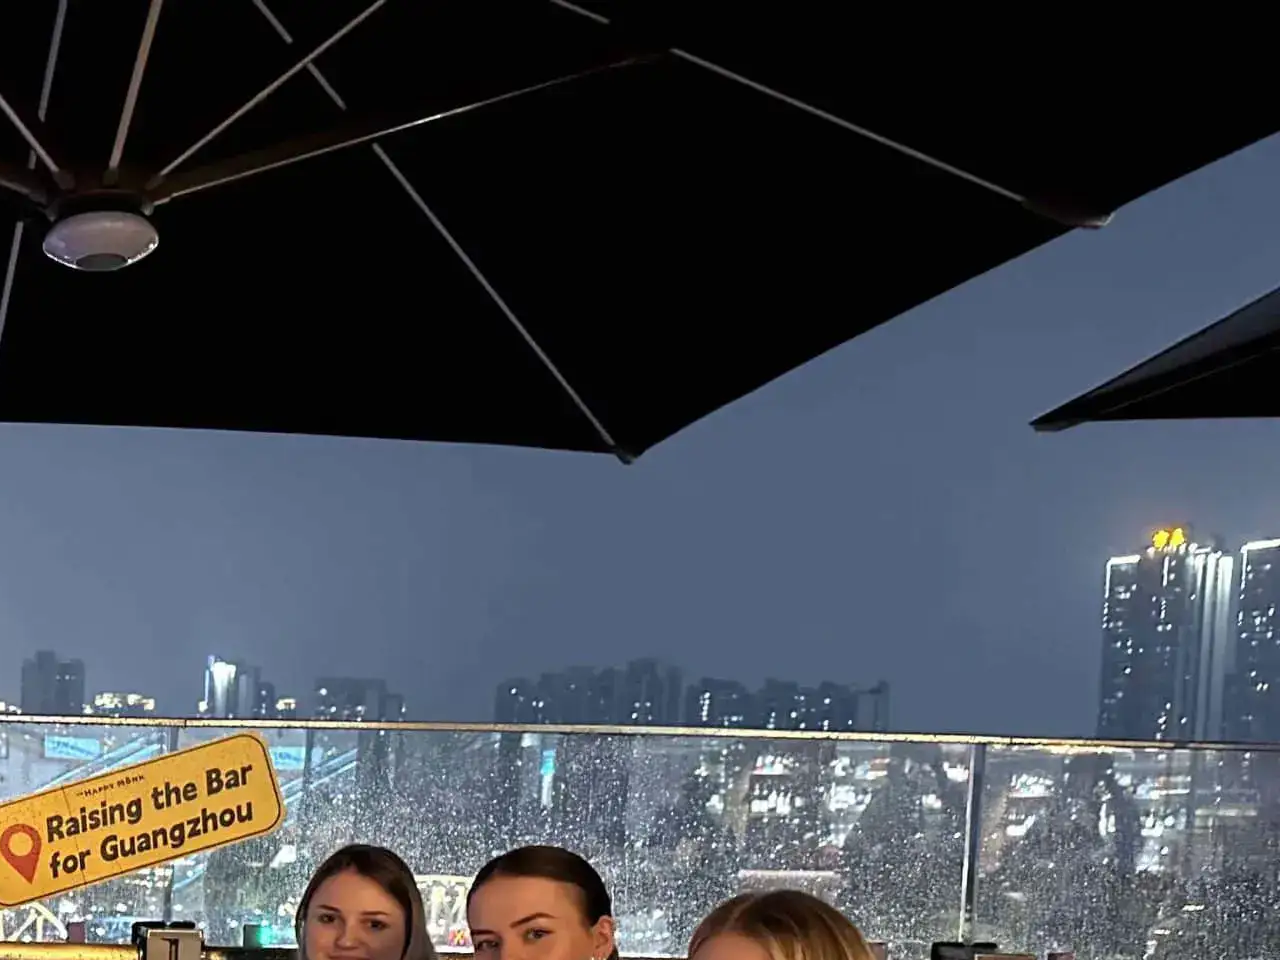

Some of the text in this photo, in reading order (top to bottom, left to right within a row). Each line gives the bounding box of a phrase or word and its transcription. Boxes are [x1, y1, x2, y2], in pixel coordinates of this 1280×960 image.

[46, 764, 253, 843] Raising the Bar
[49, 802, 253, 879] for Guangzhou
